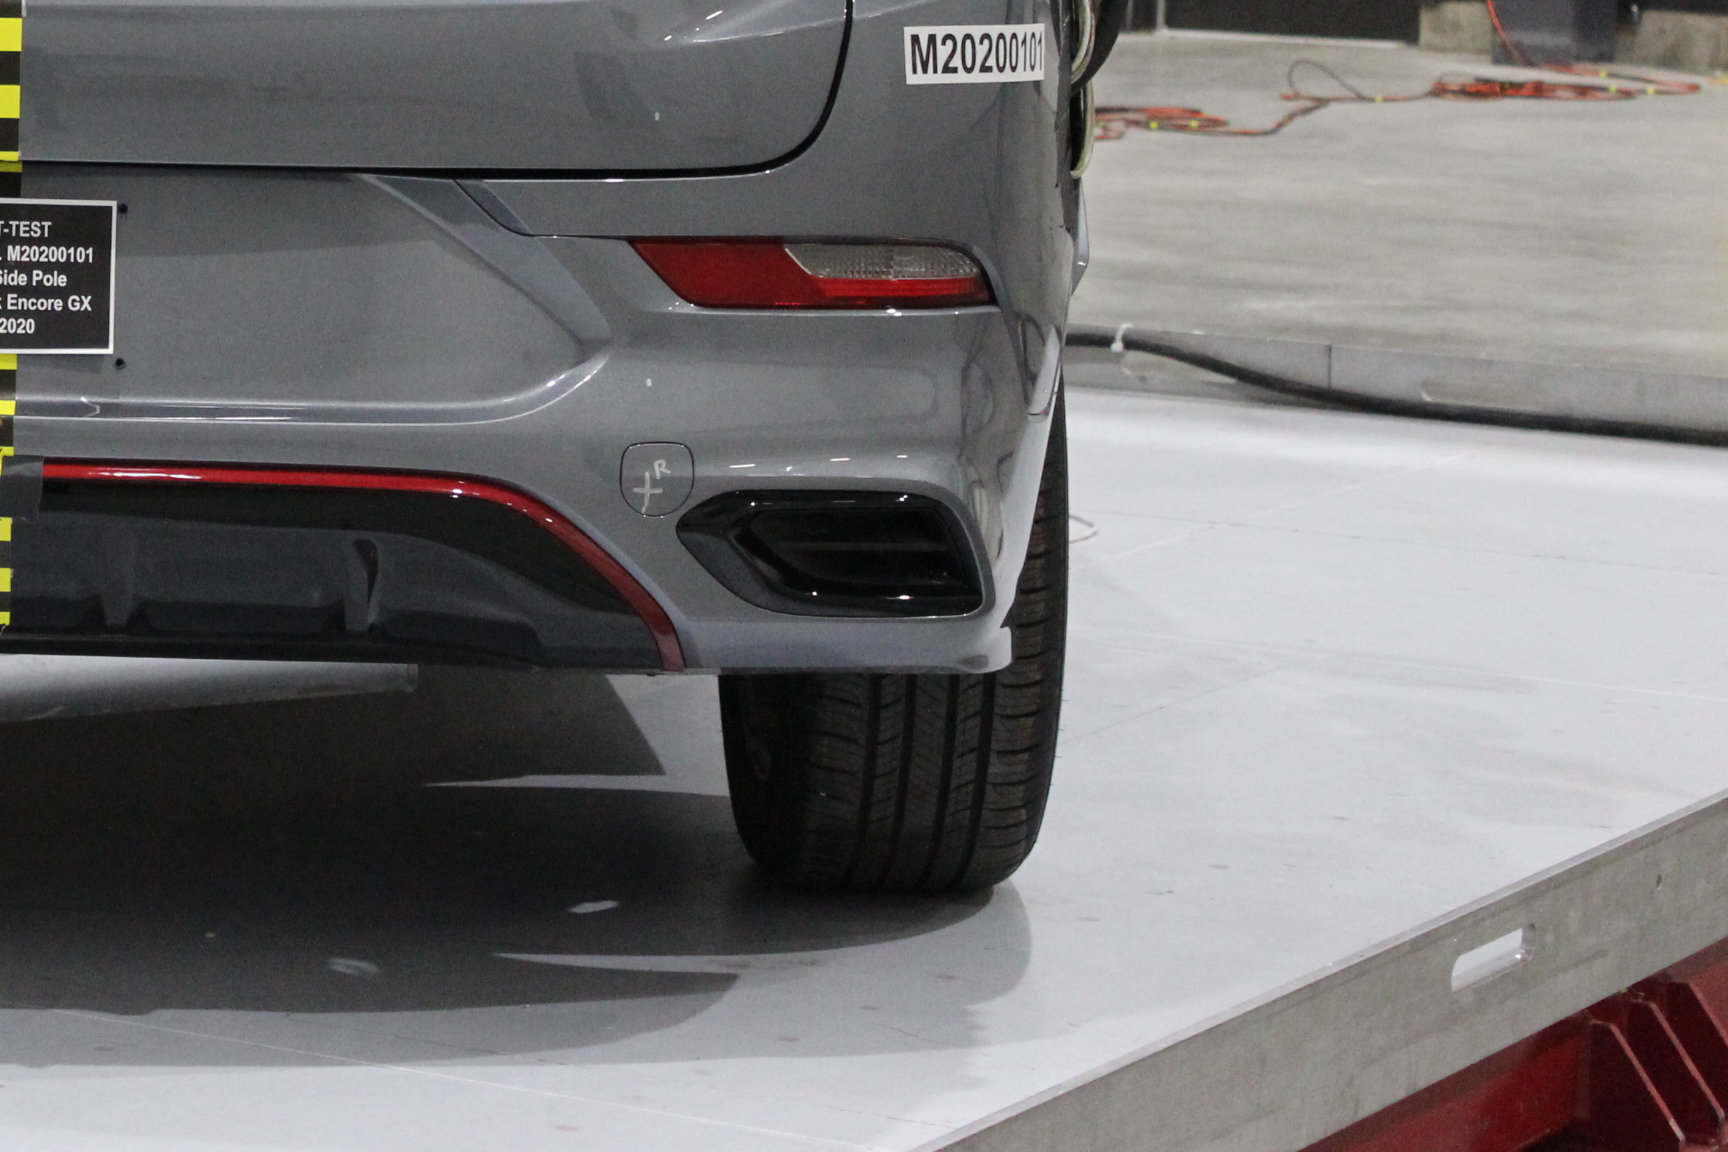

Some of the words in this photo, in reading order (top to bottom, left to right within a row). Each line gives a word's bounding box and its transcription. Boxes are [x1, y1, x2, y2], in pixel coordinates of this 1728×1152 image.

[910, 33, 1043, 75] M20200101
[7, 246, 93, 263] M20200101
[32, 270, 67, 286] Pole
[7, 294, 63, 311] Encore
[68, 295, 92, 311] GX
[653, 459, 671, 480] R
